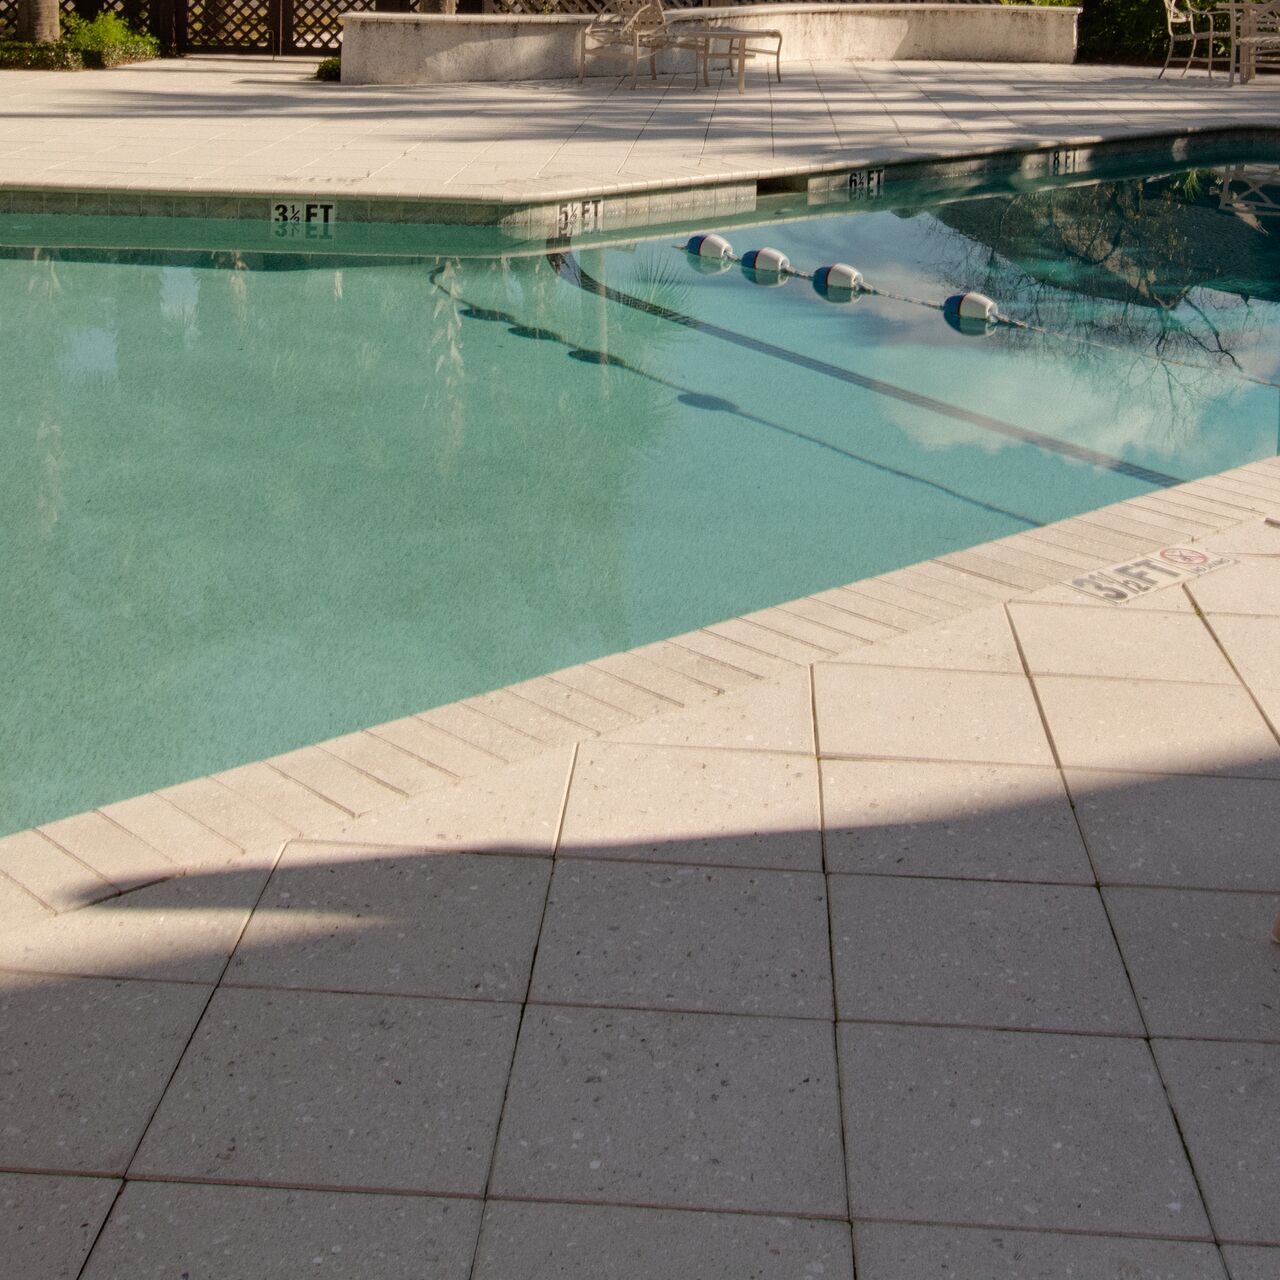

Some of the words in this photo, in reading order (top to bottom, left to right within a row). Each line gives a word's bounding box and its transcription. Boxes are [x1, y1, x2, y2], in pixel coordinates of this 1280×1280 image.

[867, 169, 884, 186] FT
[305, 204, 333, 223] FT
[581, 200, 601, 219] FT
